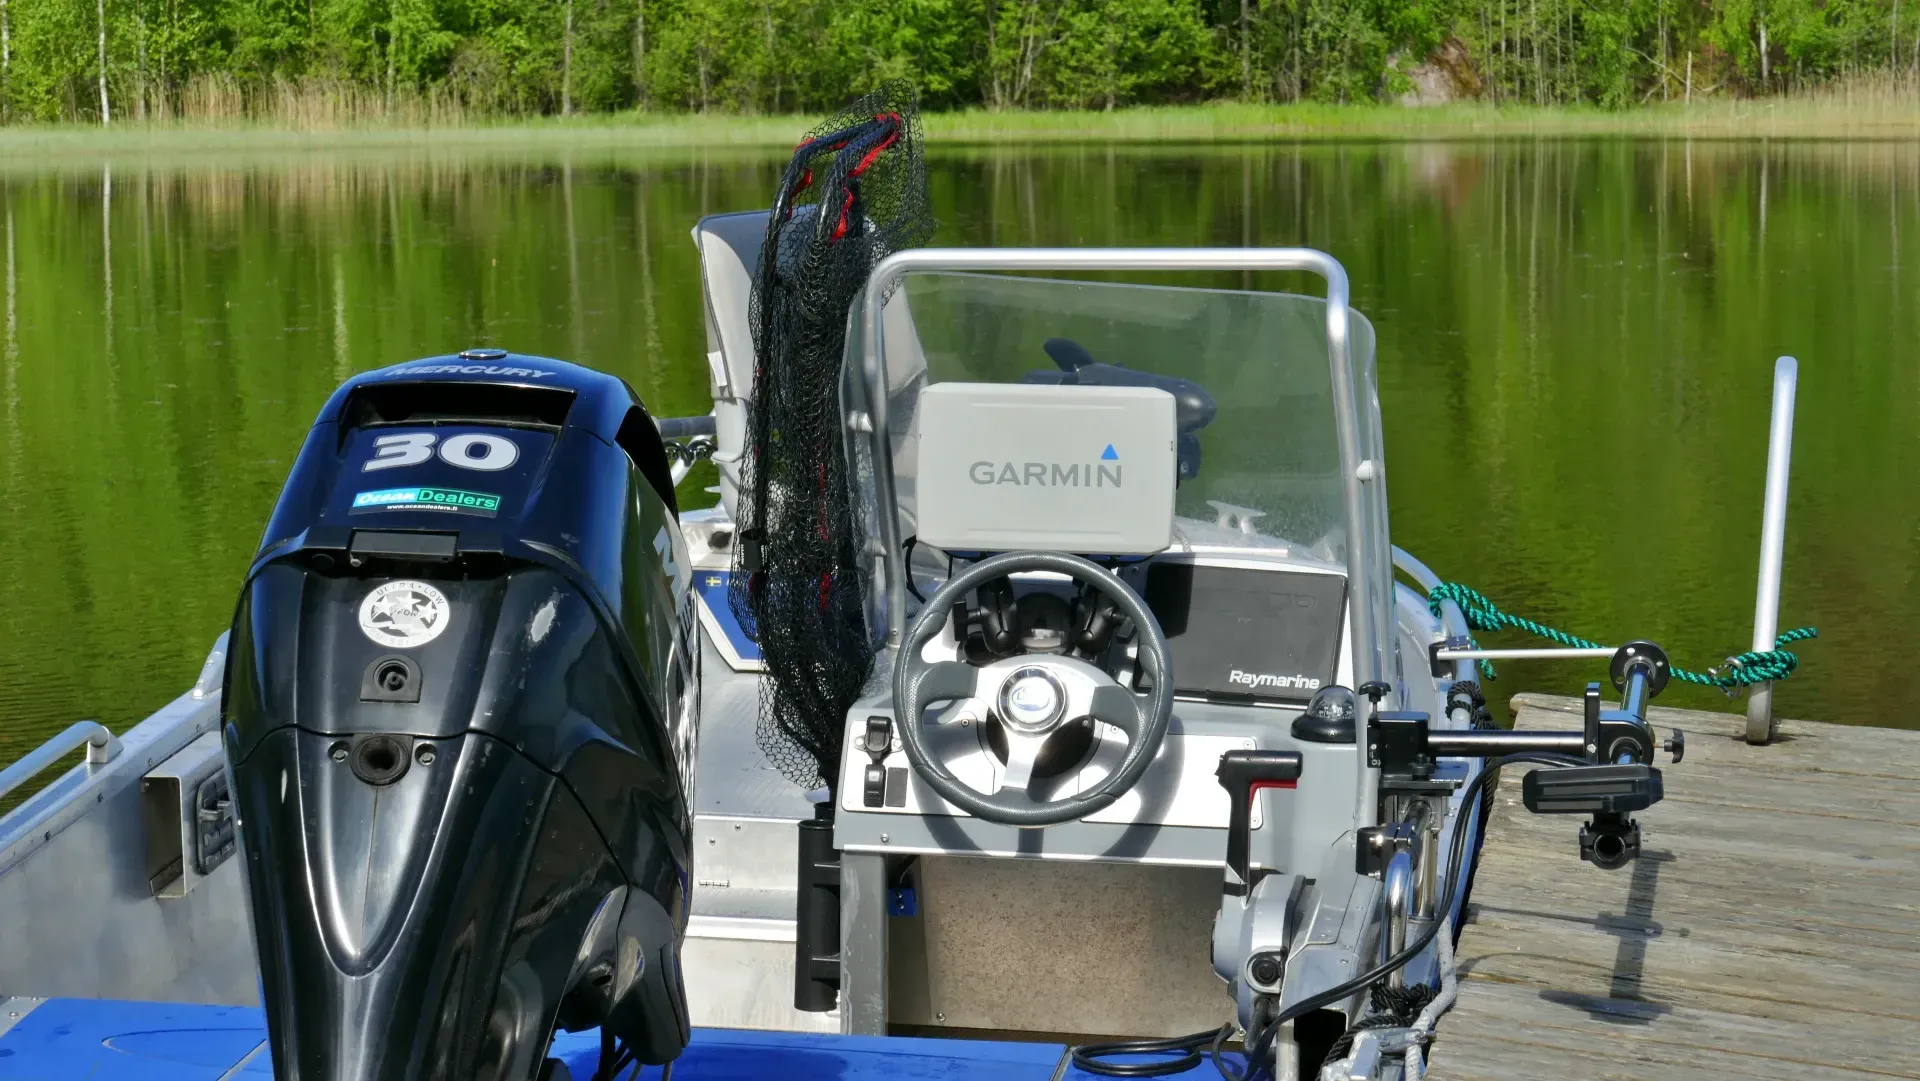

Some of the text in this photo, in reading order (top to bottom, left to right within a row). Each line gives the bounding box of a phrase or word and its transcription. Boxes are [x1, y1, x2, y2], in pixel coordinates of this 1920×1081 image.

[384, 365, 557, 378] MERCURY
[362, 433, 520, 473] 30
[968, 460, 1123, 488] GARMIN
[386, 503, 458, 511] www.oceandealers.fi
[1229, 669, 1321, 689] Raymarine
